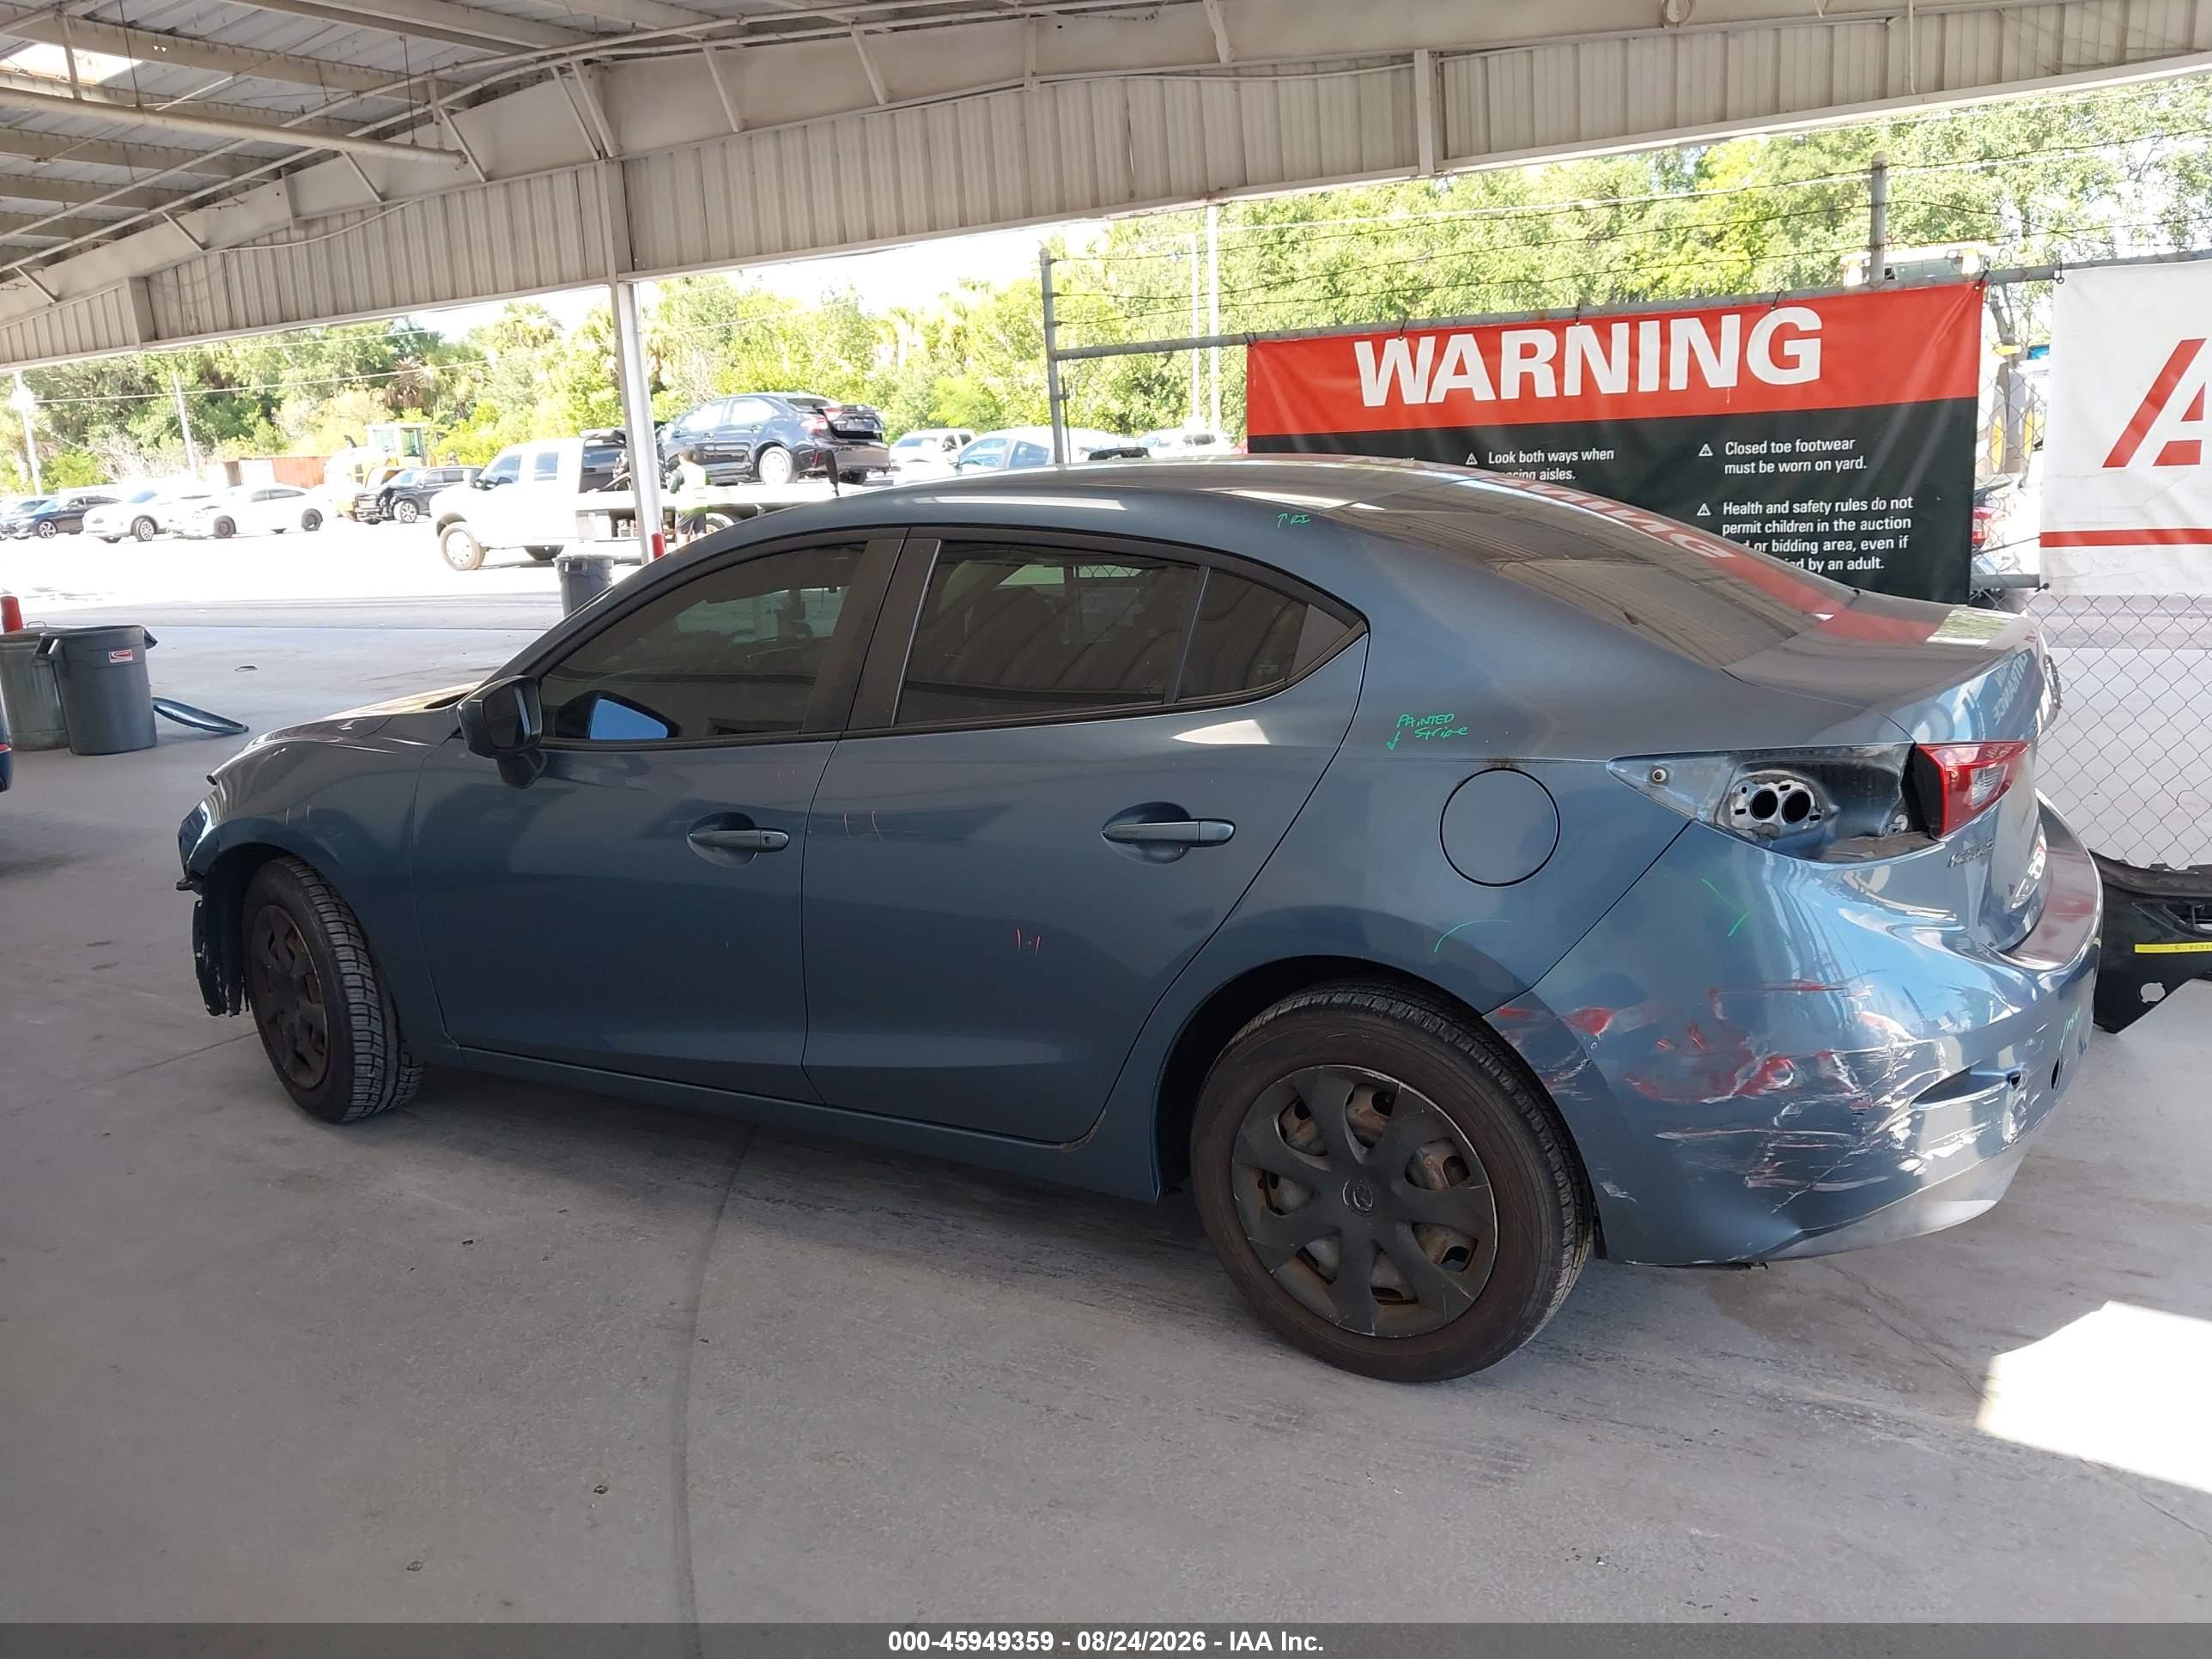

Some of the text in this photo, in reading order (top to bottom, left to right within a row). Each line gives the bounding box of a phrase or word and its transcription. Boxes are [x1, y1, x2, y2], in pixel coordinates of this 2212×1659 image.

[1354, 307, 1822, 407] WARNING
[1489, 448, 1614, 464] Look both ways when
[1725, 439, 1856, 455] Closed toe footwear
[1540, 468, 1576, 480] aisles.
[1725, 455, 1867, 474] must be worn on yard.
[1723, 496, 1913, 515] Health and safety rules do not
[1722, 516, 1911, 538] permit children in the auction
[1754, 542, 1769, 552] or
[1772, 540, 1818, 554] bidding
[1823, 541, 1856, 552] area,
[1861, 539, 1893, 550] even
[1899, 535, 1908, 549] if
[1808, 558, 1823, 574] by
[1828, 561, 1843, 570] an
[1847, 556, 1884, 570] adult.
